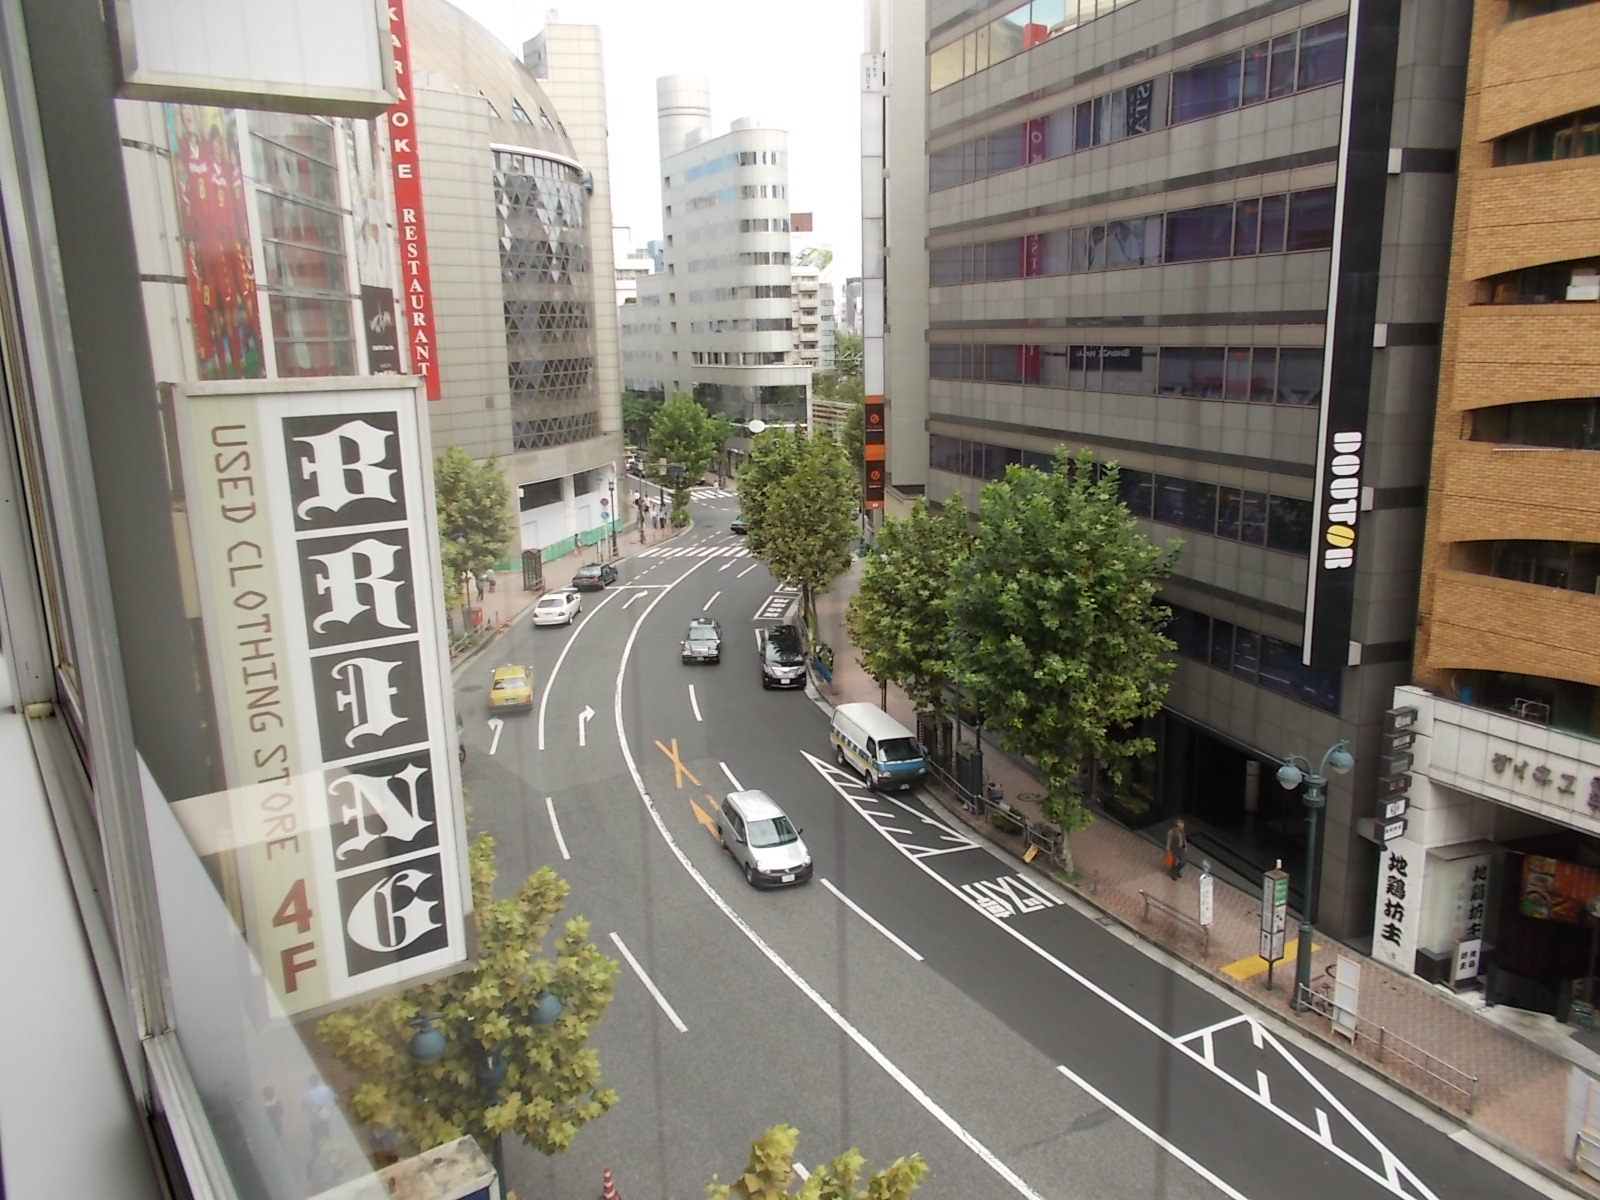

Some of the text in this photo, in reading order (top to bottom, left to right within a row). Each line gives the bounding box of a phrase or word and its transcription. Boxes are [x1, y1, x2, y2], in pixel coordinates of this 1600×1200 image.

[402, 208, 430, 376] RESTAURANT
[1323, 431, 1362, 570] DOUTOR
[212, 424, 317, 994] USED CLOTHING STORE 4F
[1381, 851, 1408, 947] 地鶏坊主
